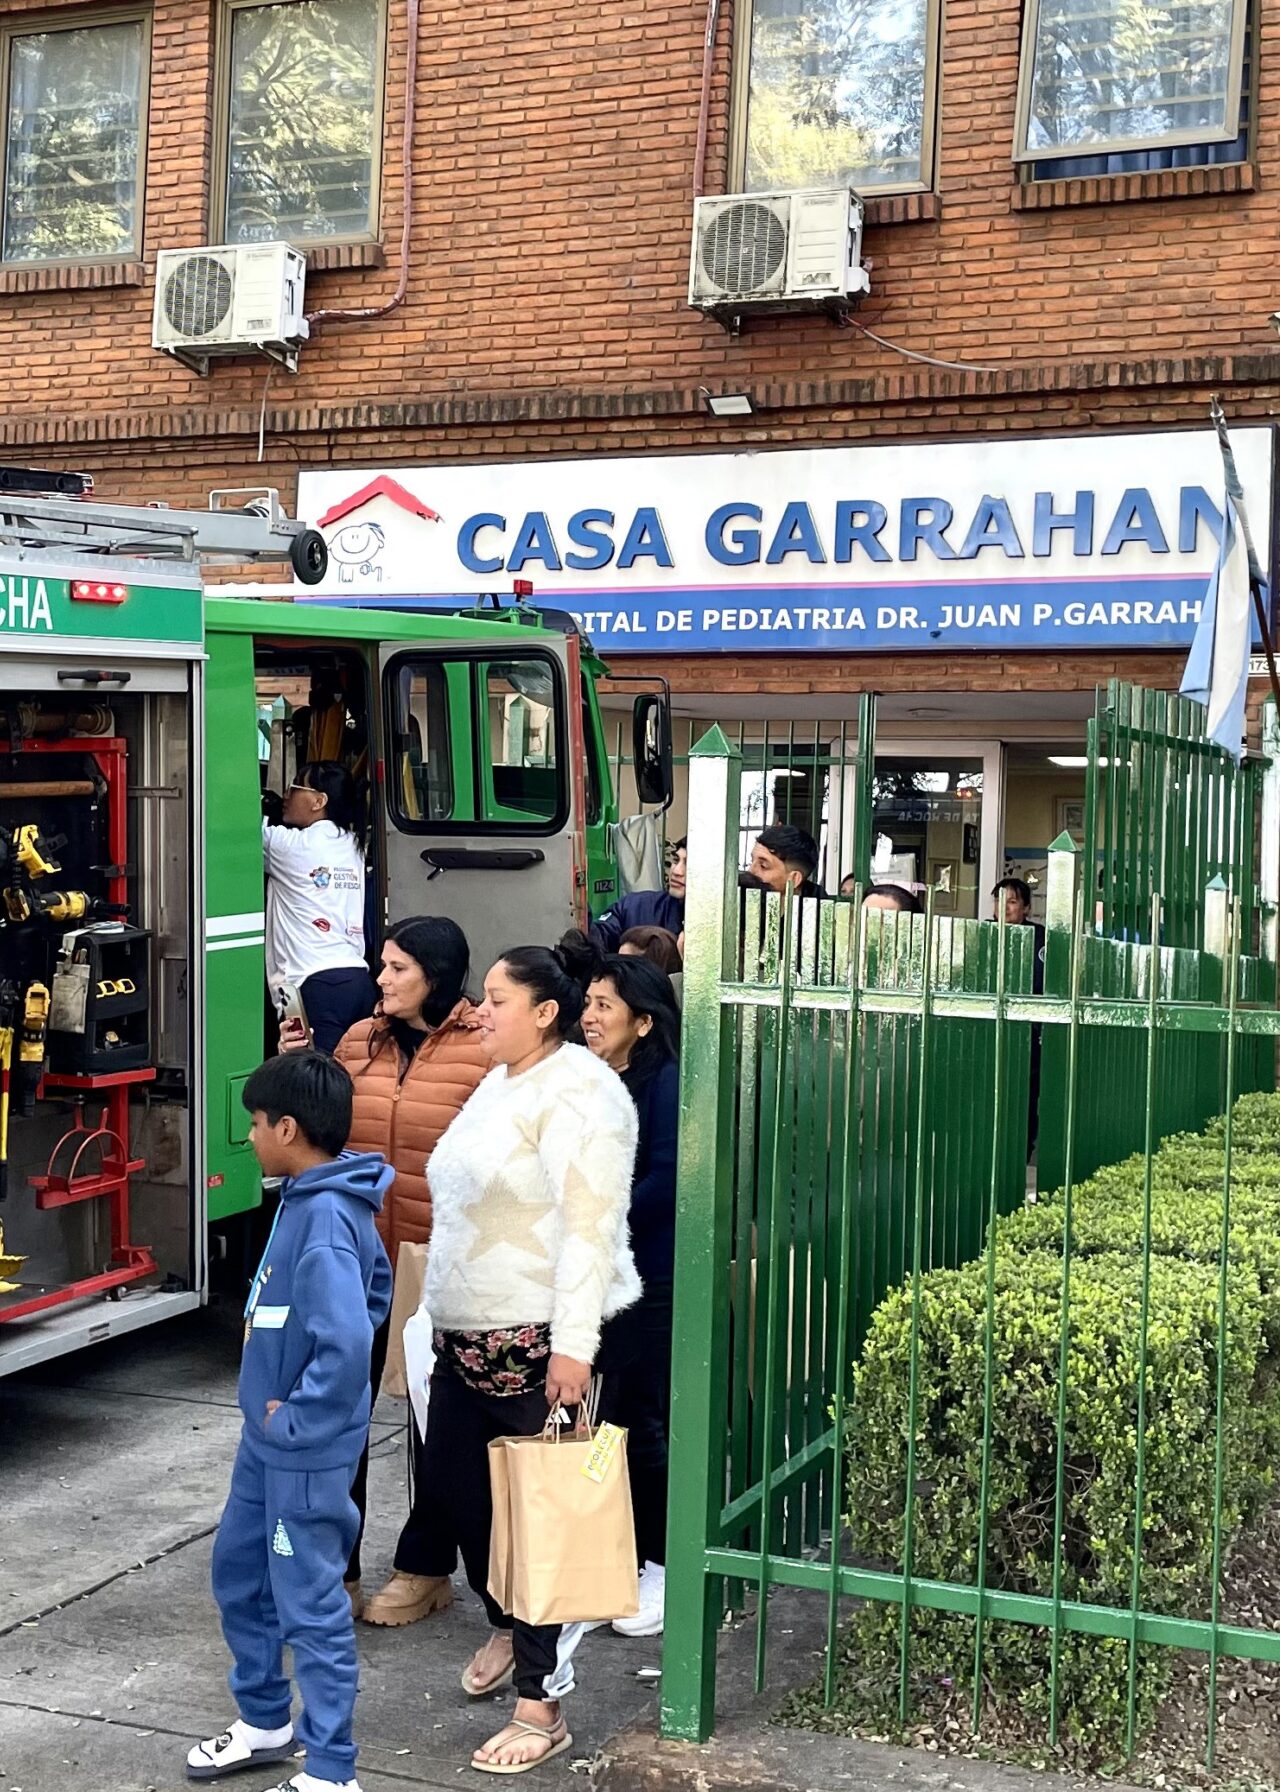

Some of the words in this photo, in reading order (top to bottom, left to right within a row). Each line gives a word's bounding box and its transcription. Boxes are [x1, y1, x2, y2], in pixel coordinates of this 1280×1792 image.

[456, 507, 675, 573] CASA
[705, 486, 1224, 566] GARRAHAN
[655, 610, 693, 632] DE
[702, 607, 867, 632] PEDIATRIA
[876, 606, 928, 629] DR.
[937, 603, 1021, 629] JUAN
